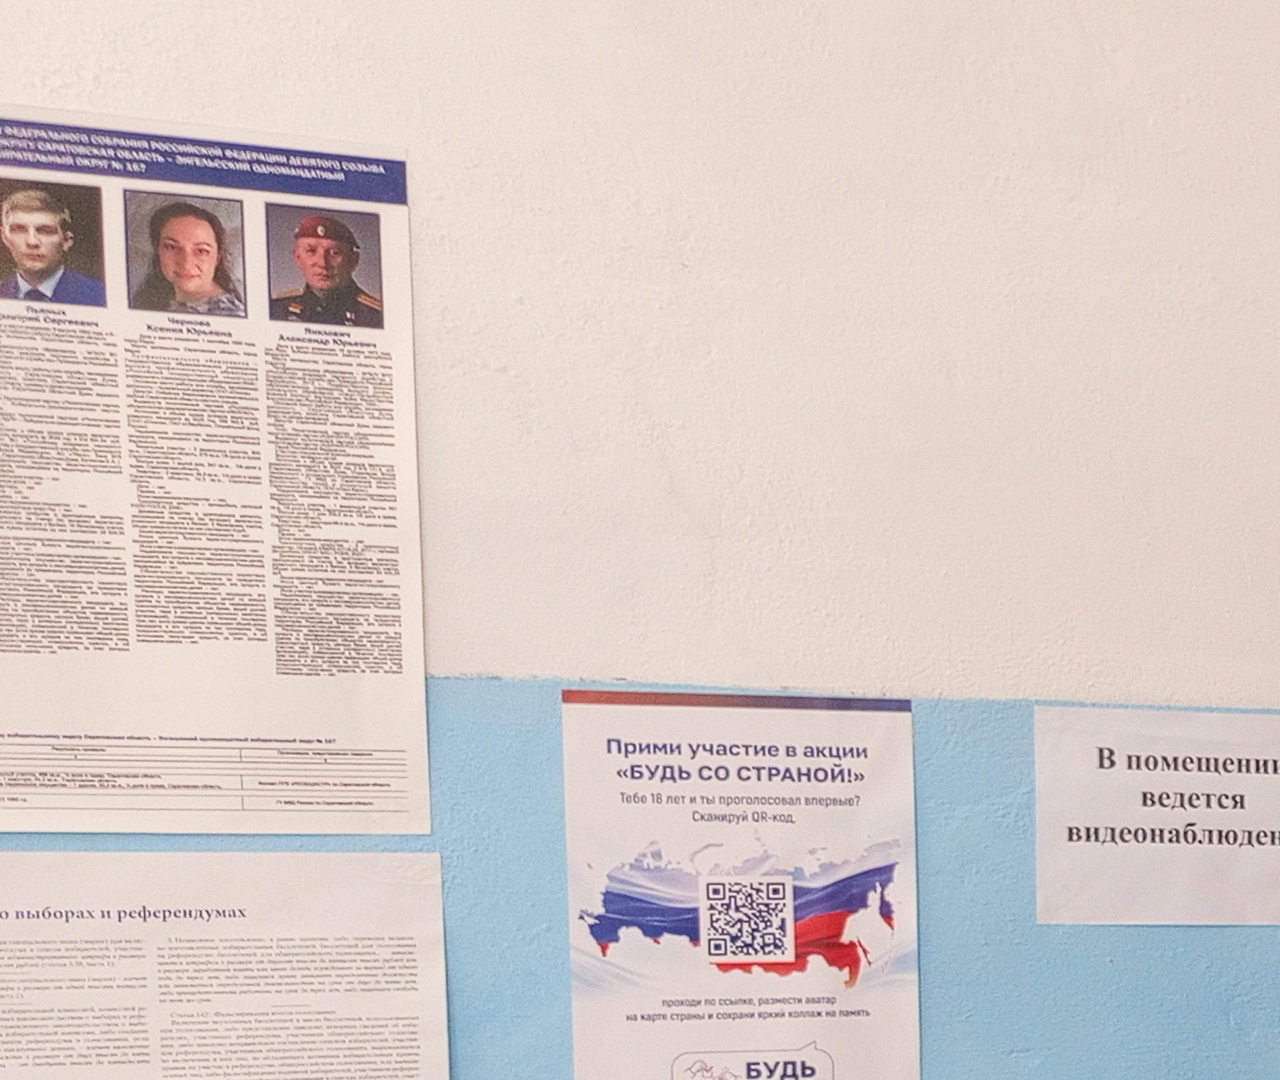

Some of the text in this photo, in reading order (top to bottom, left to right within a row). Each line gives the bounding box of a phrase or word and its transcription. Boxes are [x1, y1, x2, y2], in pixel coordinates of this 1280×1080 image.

[38, 141, 115, 158] САРАТОВСКАЯ
[117, 150, 165, 163] ОБЛАСТЬ
[91, 135, 149, 150] СОБРАНИЯ
[288, 156, 341, 170] ДЕВЯТОГО
[342, 161, 386, 175] СОЗЫВА
[76, 158, 109, 170] ОКРУГ
[168, 316, 211, 328] Чернова
[147, 324, 233, 338] Ксения Юрьевна
[279, 334, 377, 350] Александр Юрьевич
[606, 738, 868, 761] Прими участие в акции
[1096, 746, 1116, 770] В
[616, 763, 865, 784] «БУДЬ СО СТРАНОЙ!»
[620, 792, 861, 808] Тебе 18 лет и ты проголосовал впервые?
[1141, 791, 1247, 810] ведется
[692, 810, 749, 825] Сканируй
[15, 906, 96, 923] выборах
[101, 908, 111, 919] и
[117, 905, 248, 923] референдумах
[662, 996, 837, 1008] проходи по ссылке, размести аватар
[626, 1008, 871, 1022] на карте страны и сохрани яркий коллаж на память
[746, 1060, 817, 1080] БУДЬ
